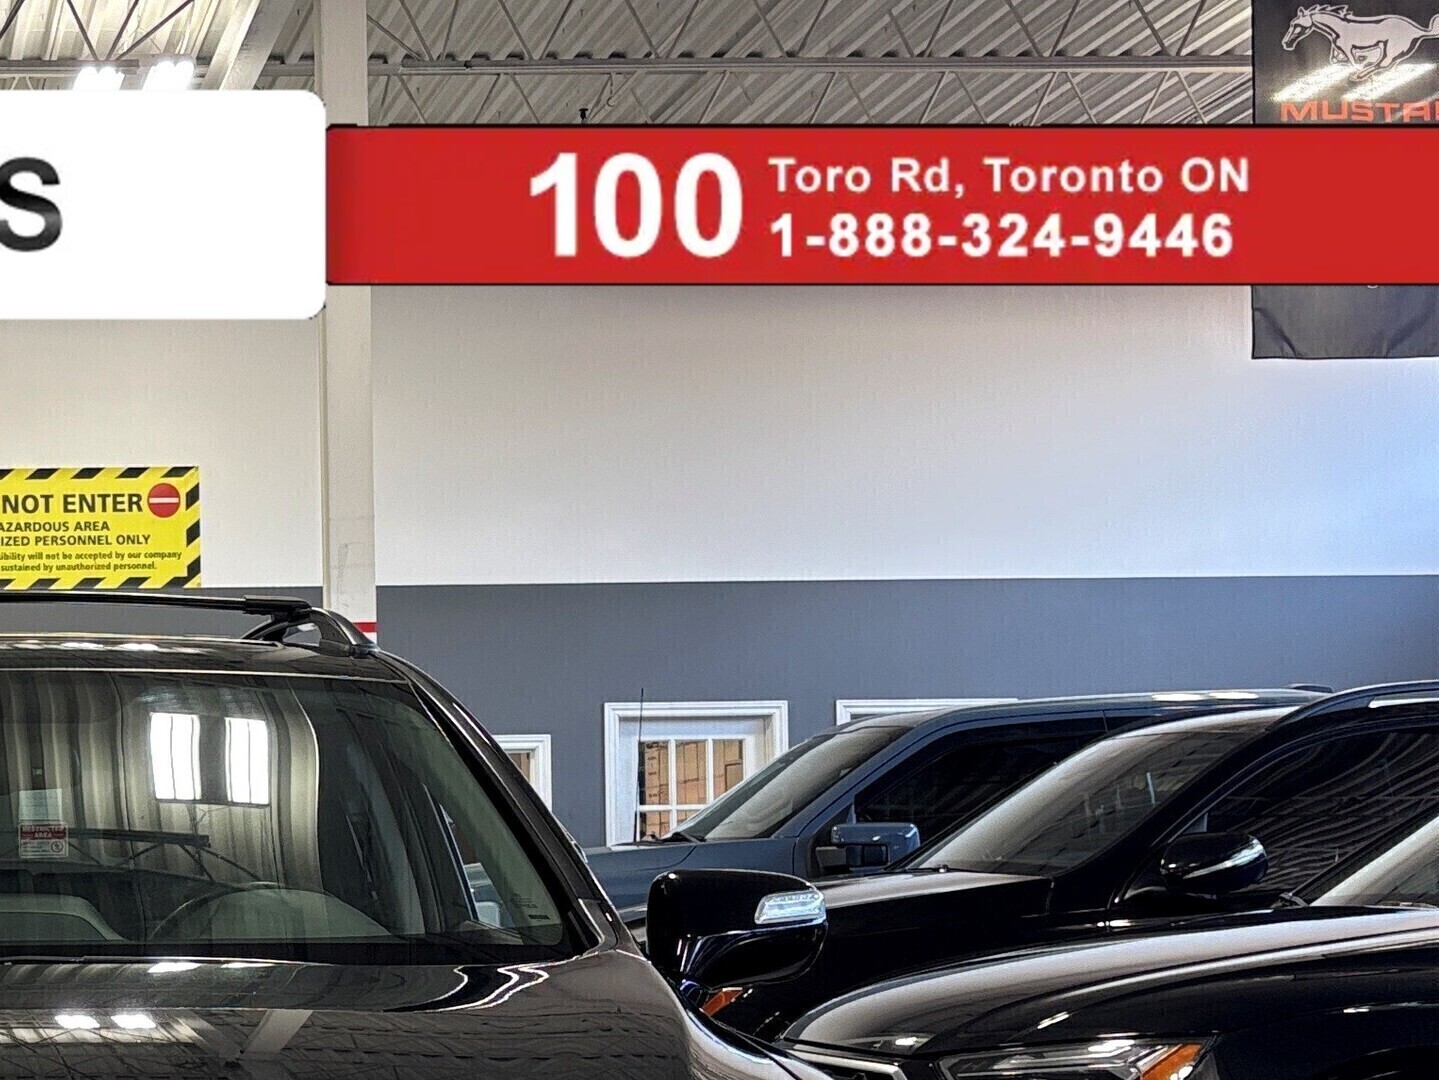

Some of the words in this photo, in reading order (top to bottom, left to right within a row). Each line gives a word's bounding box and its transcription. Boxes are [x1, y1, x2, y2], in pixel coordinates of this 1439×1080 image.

[1280, 100, 1439, 123] MUSTA
[2, 494, 54, 514] NOT
[63, 493, 143, 513] ENTER
[74, 520, 110, 532] AREA
[35, 535, 112, 547] PERSONNEL
[116, 534, 151, 545] ONLY
[27, 552, 43, 560] will
[46, 552, 60, 560] not
[62, 551, 72, 560] be
[75, 551, 113, 561] accepted
[115, 551, 125, 561] by
[144, 551, 182, 560] company
[1, 563, 40, 572] sustained
[43, 563, 53, 573] by
[56, 561, 111, 571] unauthorized
